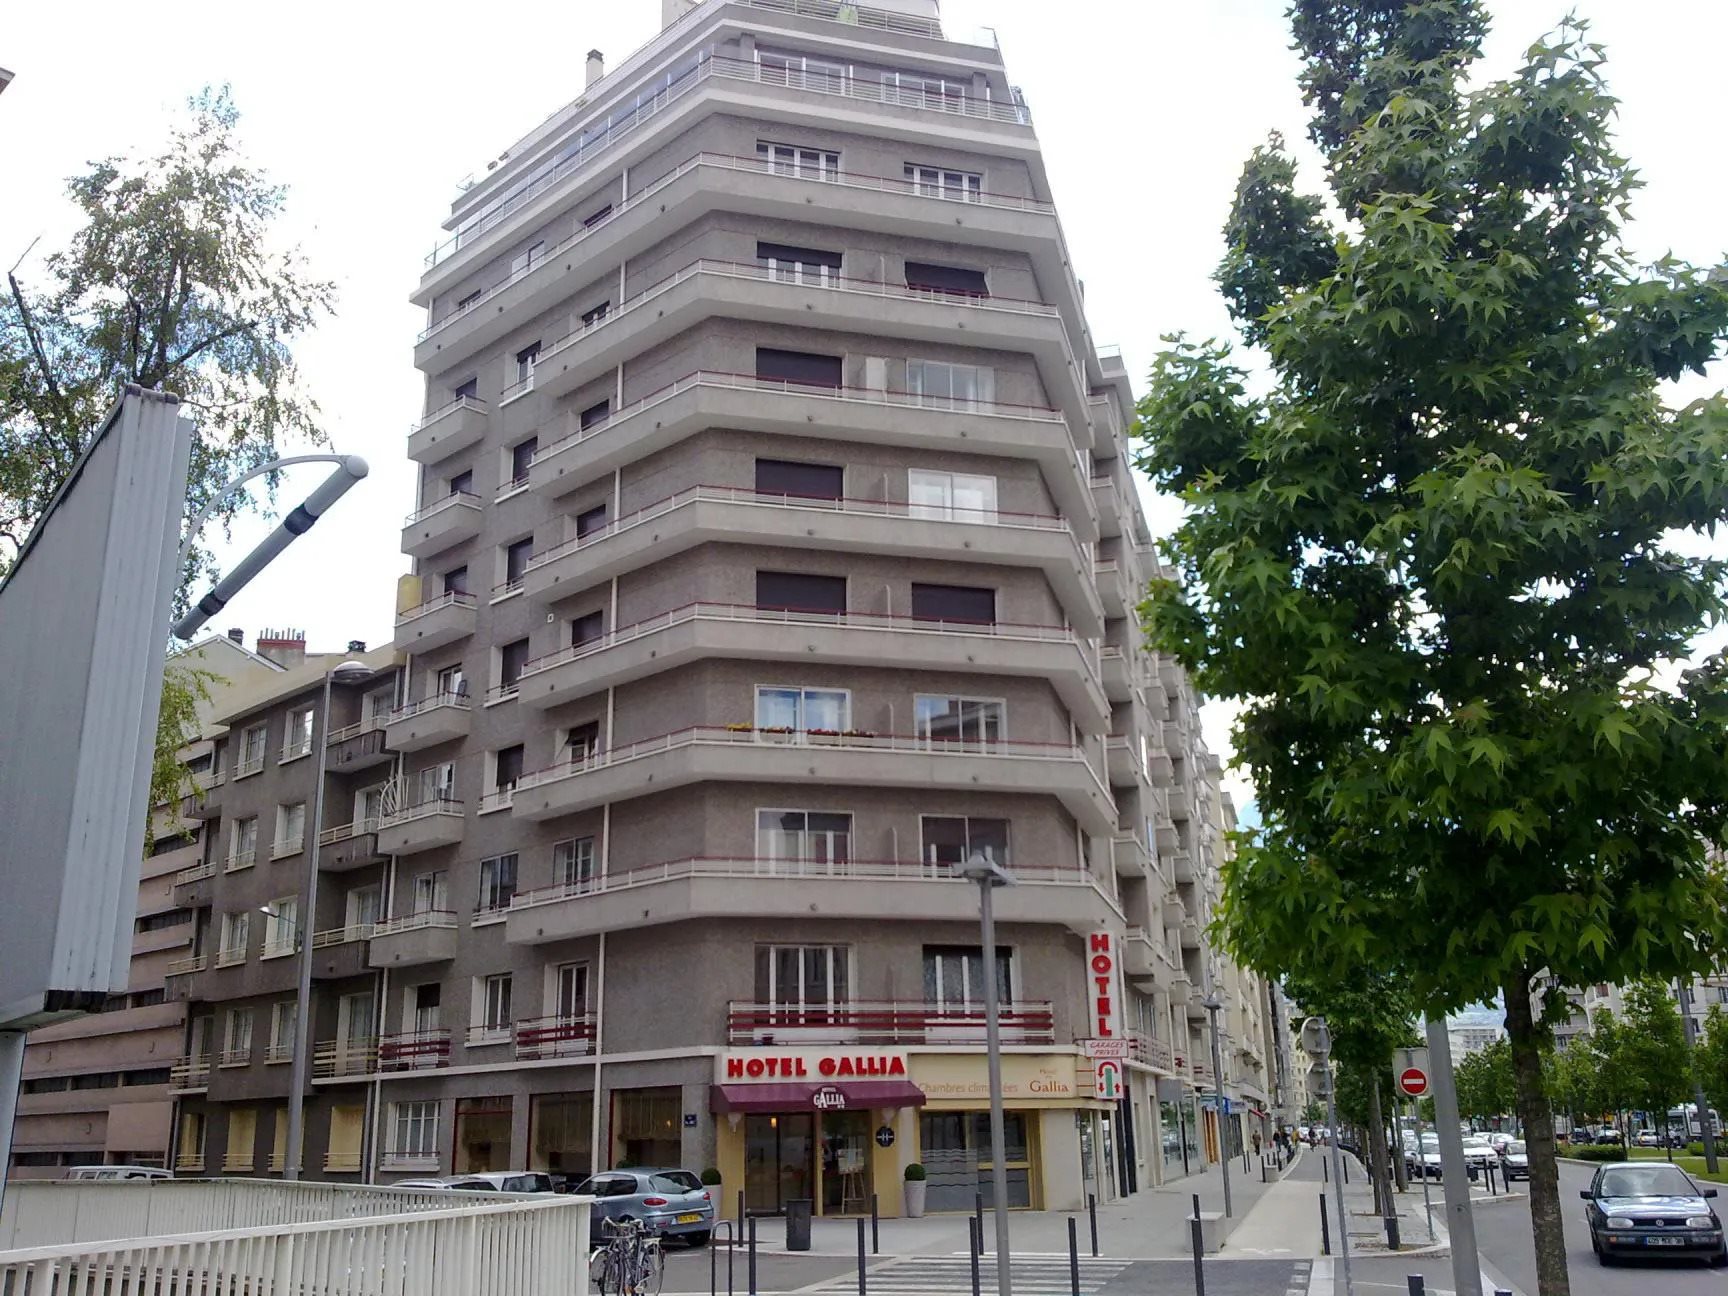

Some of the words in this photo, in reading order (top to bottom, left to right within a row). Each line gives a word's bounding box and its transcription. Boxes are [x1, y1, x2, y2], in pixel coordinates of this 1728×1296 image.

[1090, 933, 1112, 1037] HOTEL
[727, 1057, 807, 1078] HOTEL
[818, 1056, 906, 1077] GALLIA
[1029, 1079, 1069, 1093] Gallia
[813, 1091, 846, 1109] GALLIA
